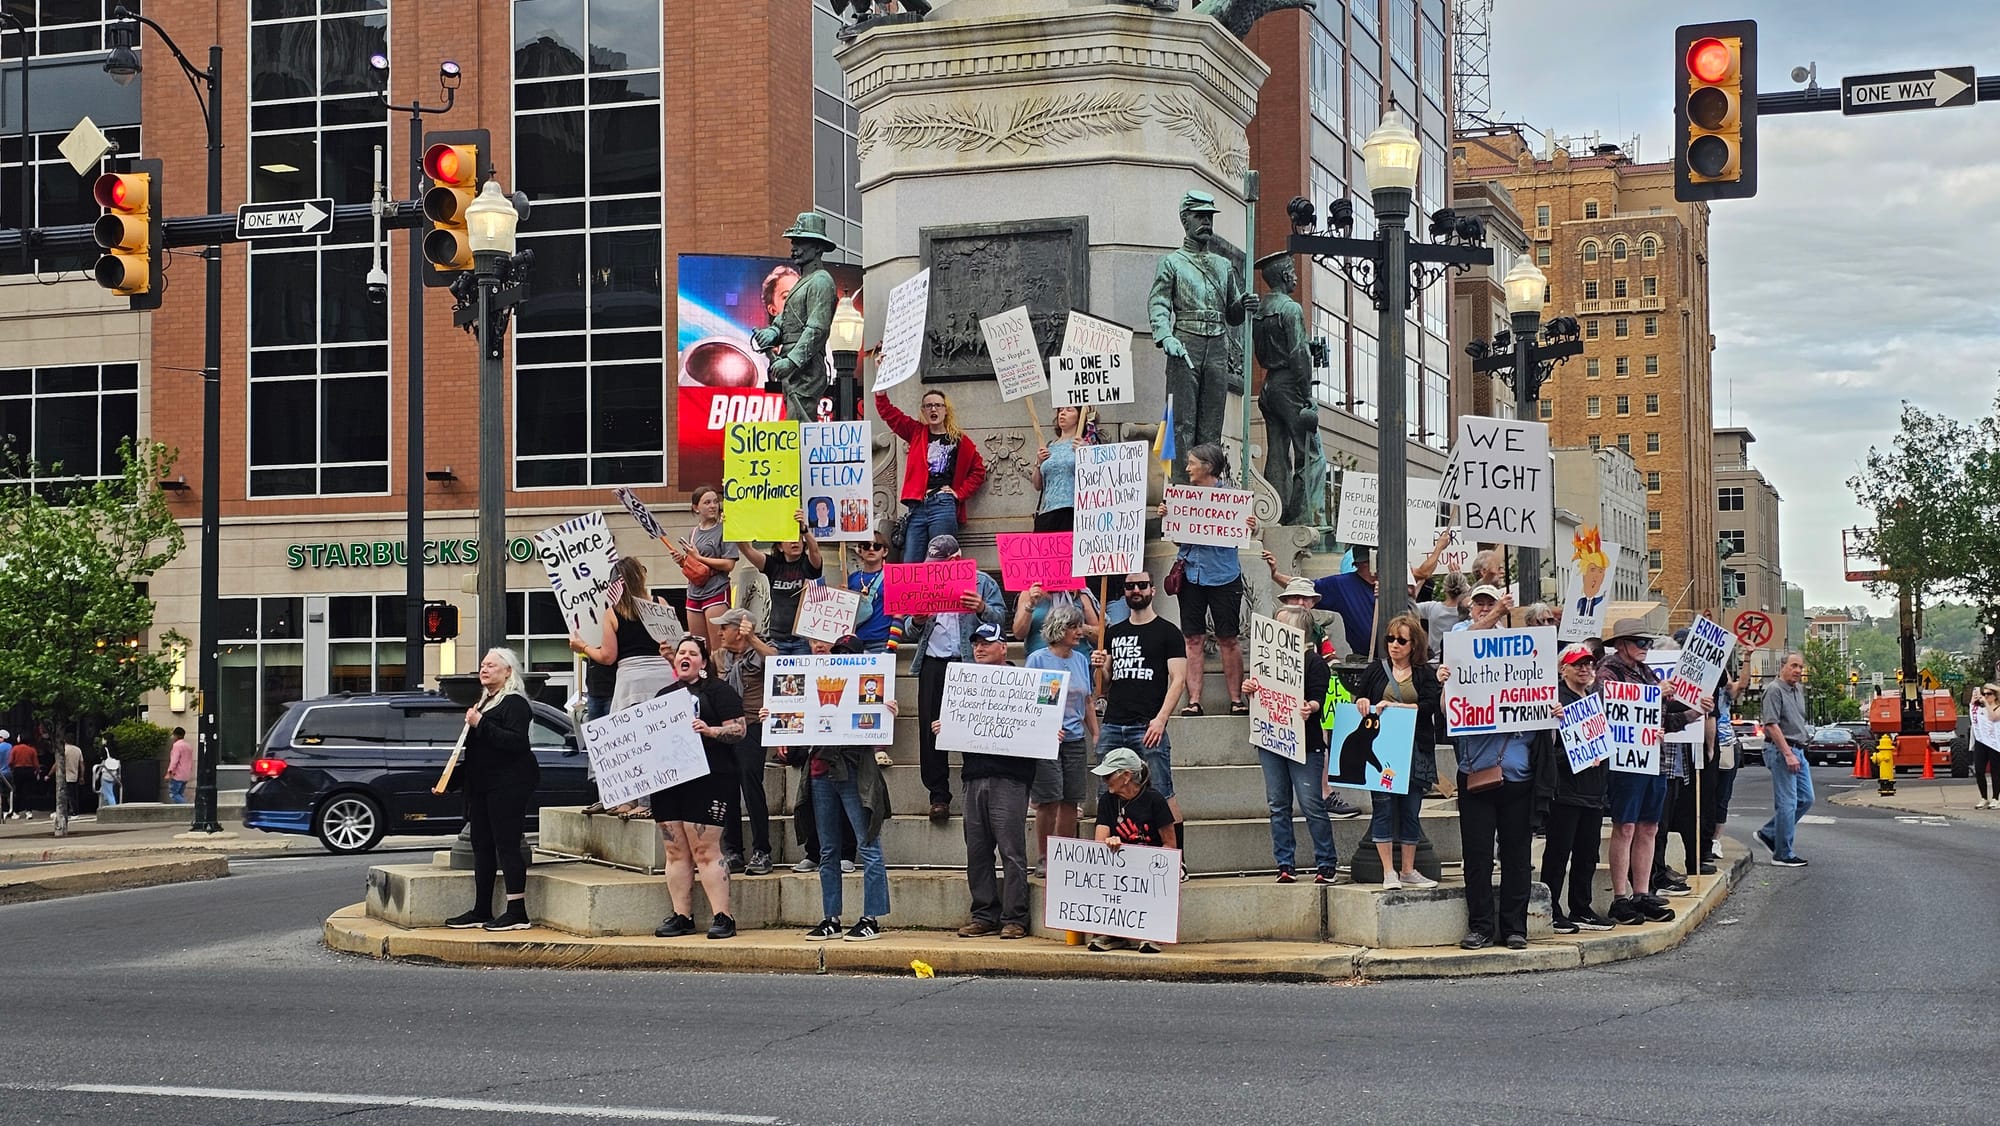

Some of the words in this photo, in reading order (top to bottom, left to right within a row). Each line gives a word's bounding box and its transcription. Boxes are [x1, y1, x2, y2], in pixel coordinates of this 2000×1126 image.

[1856, 86, 1891, 102] ONE
[1898, 82, 1934, 98] WAY
[248, 214, 272, 226] ONE
[278, 212, 304, 224] WAY
[1060, 358, 1074, 370] NO
[1080, 355, 1102, 370] ONE
[1110, 354, 1120, 368] IS
[1074, 370, 1110, 385] ABOVE
[1067, 389, 1088, 404] THE
[1098, 387, 1120, 402] LAW
[708, 394, 783, 430] BORN
[731, 424, 798, 454] Silence
[1467, 424, 1525, 452] WE
[1091, 445, 1116, 464] JESUS
[750, 460, 770, 476] IS
[810, 466, 864, 486] FELON
[1108, 461, 1142, 488] Would
[1464, 461, 1541, 492] FIGHT
[724, 478, 799, 502] Compliance
[1076, 488, 1114, 511] MAGA
[1344, 492, 1377, 504] REPUBL
[1098, 512, 1114, 532] OR
[1174, 506, 1239, 520] DEMOCRACY
[1466, 502, 1536, 534] BACK
[1166, 522, 1180, 532] IN
[1189, 524, 1248, 538] DISTRESS!
[1352, 520, 1378, 530] CRUE
[541, 533, 604, 568] Silence
[1010, 536, 1072, 558] CONGRES
[572, 562, 591, 580] IS
[892, 566, 923, 584] DUE
[926, 563, 974, 582] PROCESS
[1005, 562, 1020, 578] DO
[1024, 562, 1051, 578] YOUR
[1056, 561, 1072, 578] JO
[1087, 553, 1134, 574] AGAIN?
[802, 600, 854, 620] GREAT
[810, 617, 850, 634] YET?
[1695, 618, 1728, 648] BRING
[1738, 616, 1766, 643] 47
[1112, 636, 1138, 648] NAZI
[1254, 620, 1274, 644] NO
[1278, 628, 1300, 654] ONE
[1473, 635, 1538, 659] UNITED,
[776, 658, 810, 667] CONALD
[816, 656, 877, 667] McDONALD'S
[1112, 646, 1142, 659] LIVES
[1258, 646, 1270, 659] IS
[1276, 649, 1302, 674] ABOVE
[1688, 636, 1724, 668] KILMAR
[1113, 657, 1145, 670] DON'T
[1457, 666, 1478, 684] We
[1480, 664, 1500, 684] the
[1504, 660, 1543, 686] People
[982, 675, 988, 684] a
[991, 670, 1036, 687] CLOWN
[1112, 668, 1154, 680] MATTER
[1254, 662, 1272, 678] THE
[1276, 670, 1302, 688] LAW!
[947, 685, 978, 696] moves
[980, 686, 997, 697] into
[1008, 688, 1036, 703] palace
[1252, 677, 1297, 708] PRESIDENTS
[1500, 686, 1556, 703] AGAINST
[1604, 682, 1640, 702] STAND
[1644, 686, 1660, 702] UP
[1673, 676, 1703, 706] HOME
[946, 696, 956, 708] he
[988, 700, 1019, 712] become
[1024, 702, 1042, 716] King
[1260, 699, 1275, 711] ARE
[1277, 702, 1293, 716] NOT
[1449, 694, 1494, 727] Stand
[1606, 702, 1629, 722] FOR
[1634, 706, 1660, 725] THE
[610, 713, 630, 728] THIS
[635, 708, 644, 718] IS
[950, 709, 966, 722] The
[968, 712, 994, 728] palace
[996, 712, 1028, 727] becomes
[590, 730, 636, 760] DEMOCRACY
[645, 720, 666, 735] DIES
[1254, 718, 1276, 738] SAVE
[1278, 728, 1299, 744] OUR
[1562, 730, 1572, 742] IS
[1574, 730, 1582, 746] A
[1581, 714, 1606, 740] GROUP
[1642, 728, 1658, 746] OF
[1262, 735, 1296, 757] COUNTRY!
[1569, 734, 1608, 768] PROJECT
[596, 742, 652, 772] THUNDEROUS
[1616, 748, 1650, 768] LAW
[1064, 870, 1106, 890] PLACE
[1113, 874, 1128, 892] IS
[1130, 877, 1149, 894] IN
[1102, 894, 1122, 904] THE
[1060, 902, 1147, 928] RESISTANCE
